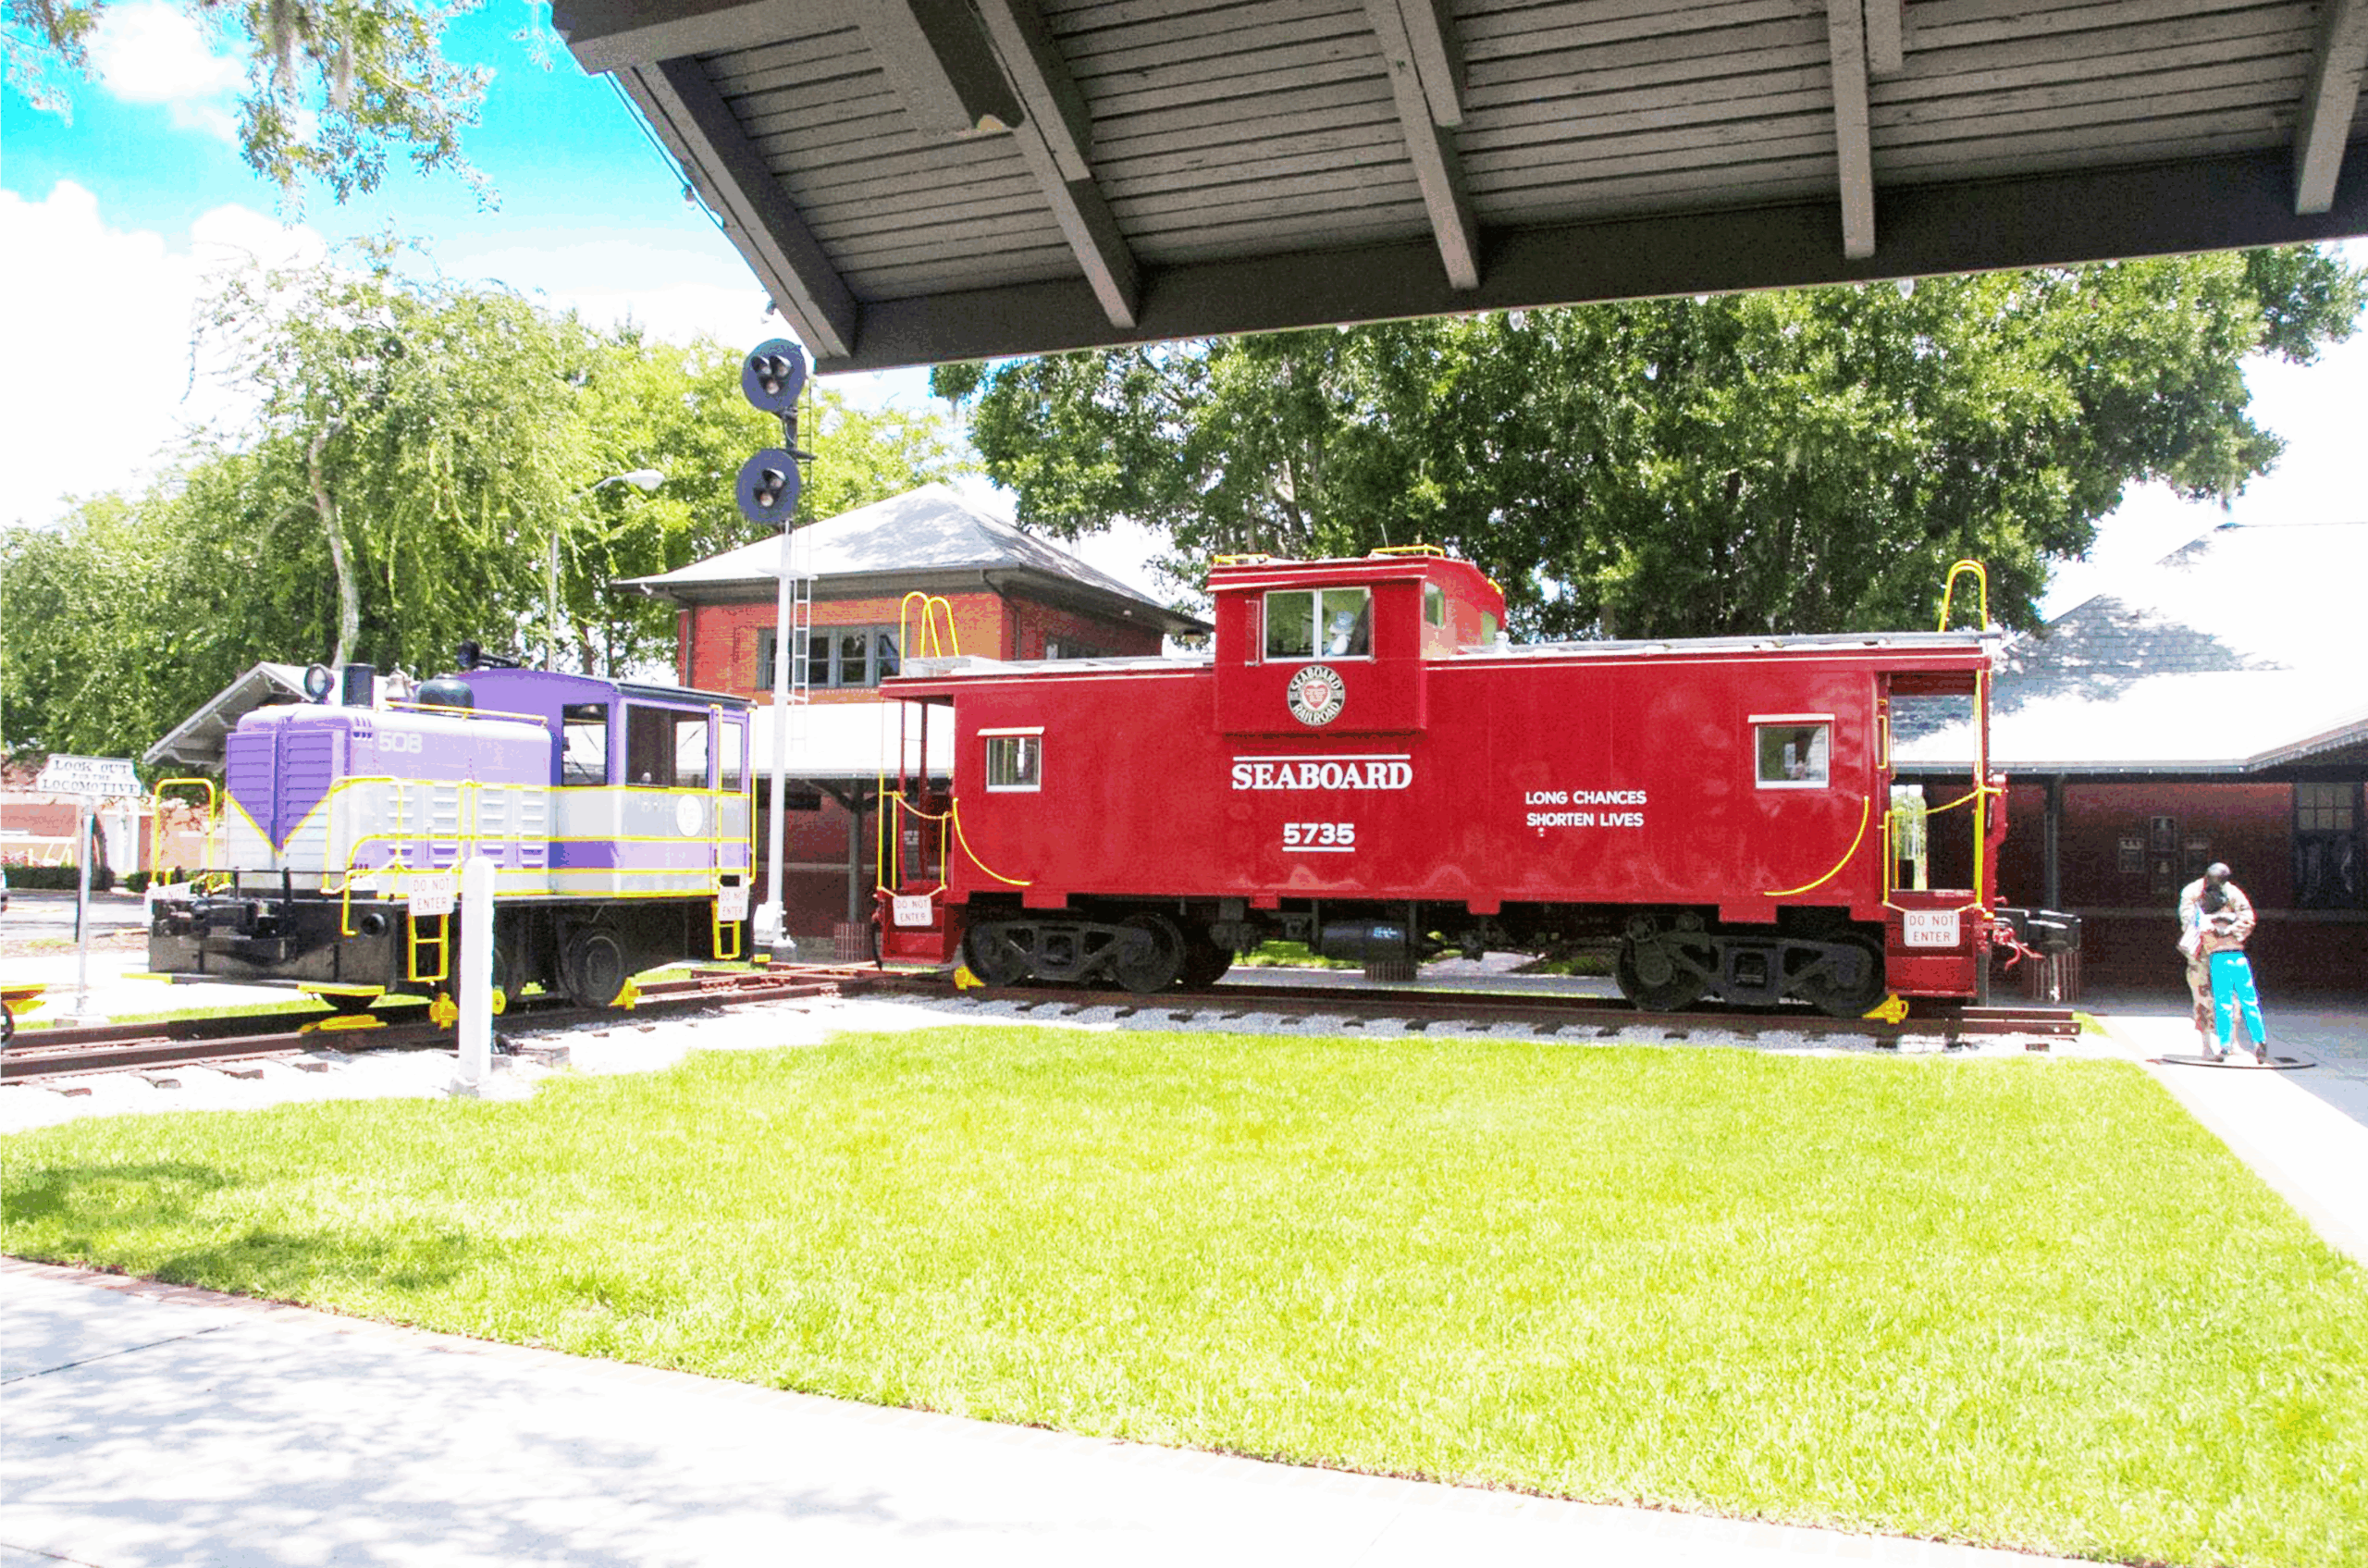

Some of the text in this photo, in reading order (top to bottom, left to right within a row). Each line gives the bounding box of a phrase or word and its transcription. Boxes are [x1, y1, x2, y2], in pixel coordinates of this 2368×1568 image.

[1290, 666, 1342, 690] SEABOARD
[1292, 701, 1340, 723] RAILROAD
[378, 731, 423, 754] 508
[53, 759, 130, 774] LOOK OUT
[1231, 762, 1412, 790] SEABOARD
[42, 778, 139, 795] LOCOMOTIVE
[1525, 790, 1647, 805] LONG CHANCES
[1526, 812, 1645, 827] SHORTEN LIVES
[1282, 822, 1356, 845] 5735
[413, 878, 450, 892] DO NOT
[416, 896, 448, 911] ENTER
[895, 898, 928, 909] DO NOT
[899, 912, 927, 923] ENTER
[1909, 915, 1955, 926] DO NOT
[1913, 931, 1951, 943] ENTER
